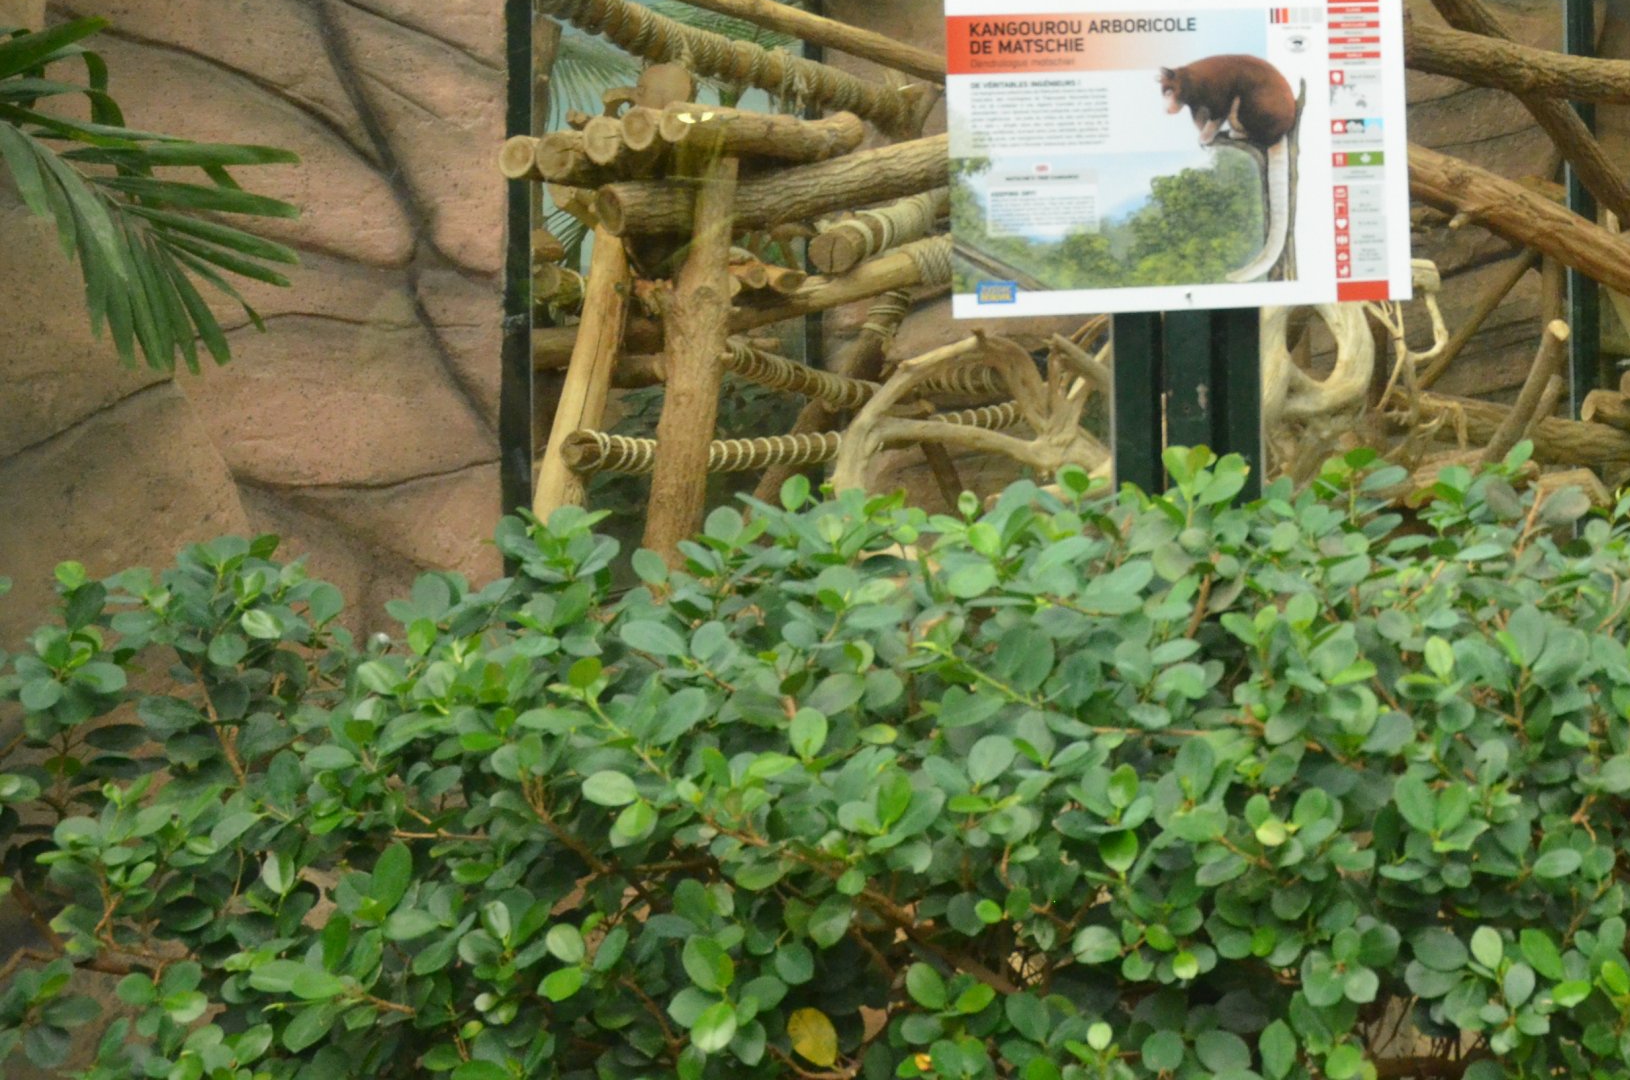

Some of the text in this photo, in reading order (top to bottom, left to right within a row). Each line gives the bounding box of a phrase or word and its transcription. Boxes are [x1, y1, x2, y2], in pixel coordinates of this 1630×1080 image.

[969, 17, 1197, 37] KANGOUROU ARBORICOLE
[969, 38, 1084, 55] DE MATSCHIE
